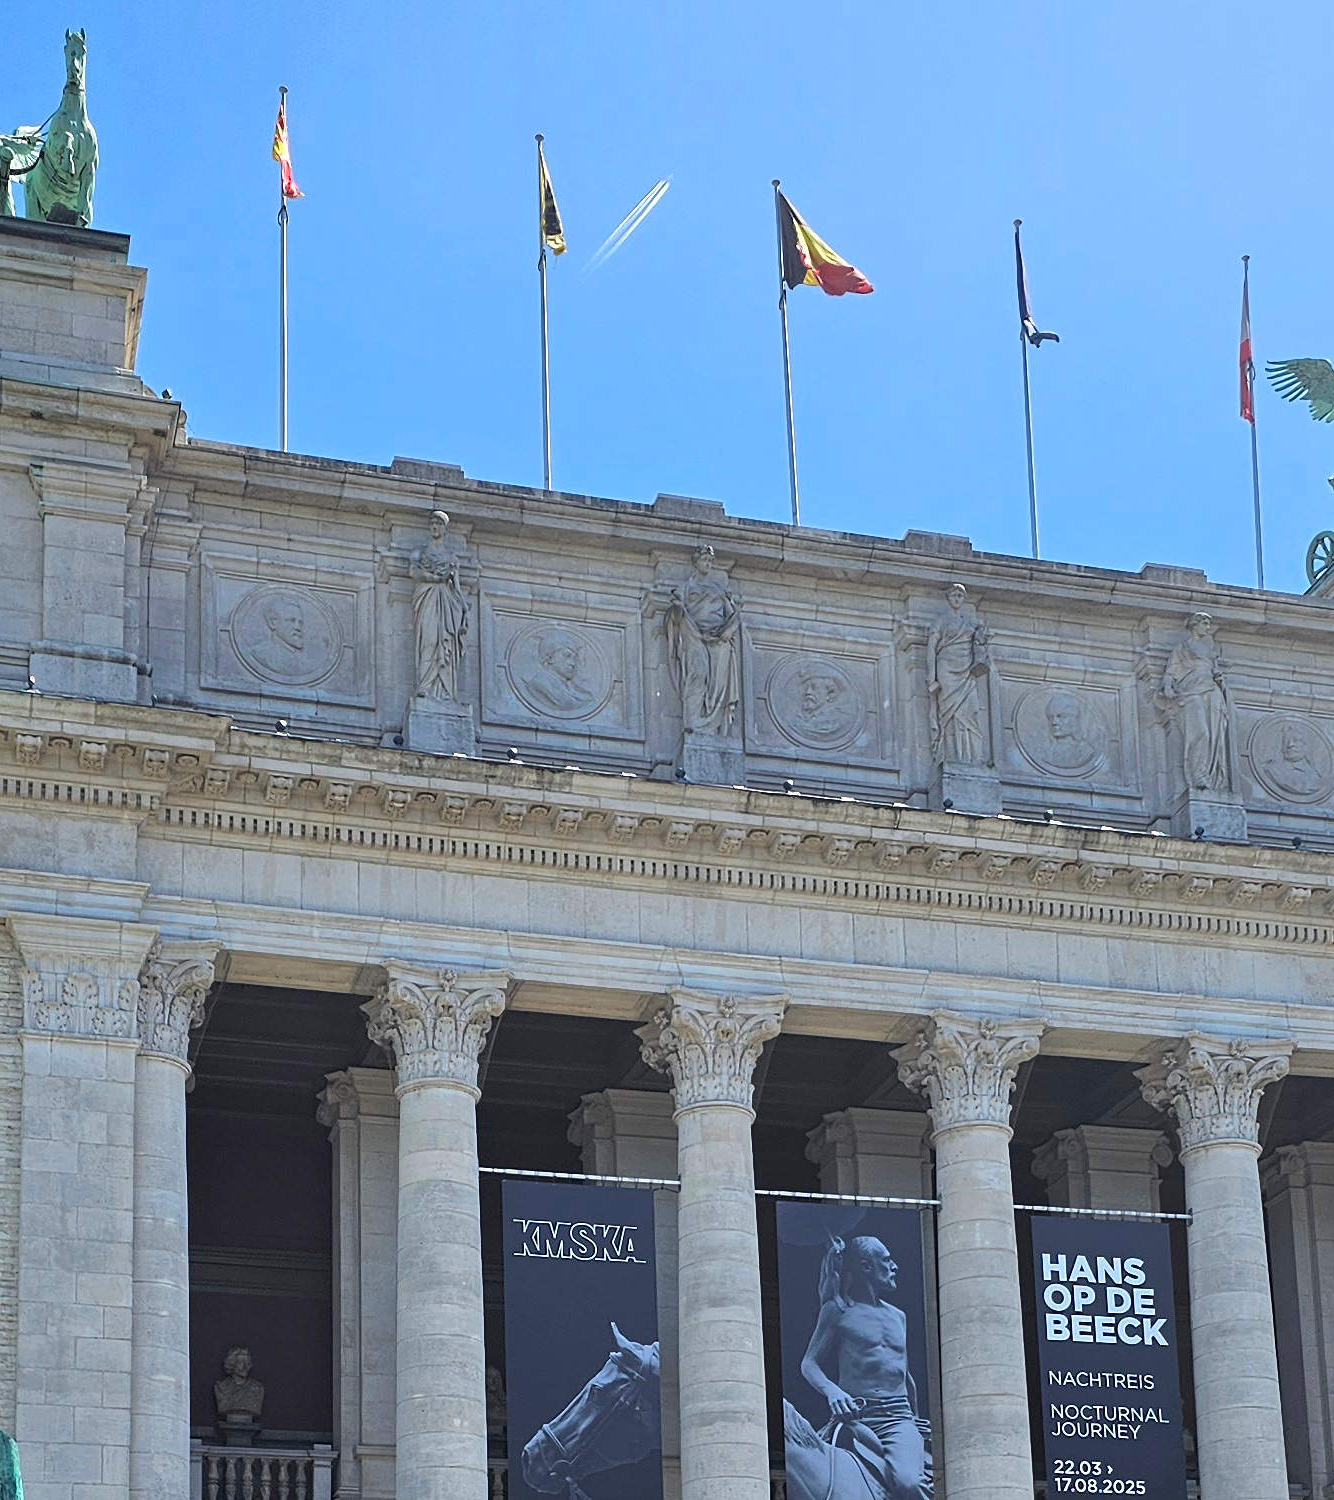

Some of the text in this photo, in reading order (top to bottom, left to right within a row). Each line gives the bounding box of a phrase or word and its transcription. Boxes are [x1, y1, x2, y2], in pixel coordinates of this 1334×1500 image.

[512, 1218, 647, 1263] KMSKA
[1041, 1252, 1146, 1286] HANS
[1043, 1283, 1156, 1316] OP DE
[1045, 1312, 1169, 1346] BEECK
[1048, 1370, 1155, 1390] NACHTREIS
[1050, 1403, 1170, 1424] NOCTURNAL
[1051, 1421, 1142, 1440] JOURNEY
[1053, 1459, 1102, 1476] 22.03
[1054, 1477, 1146, 1495] 17.08.2025
